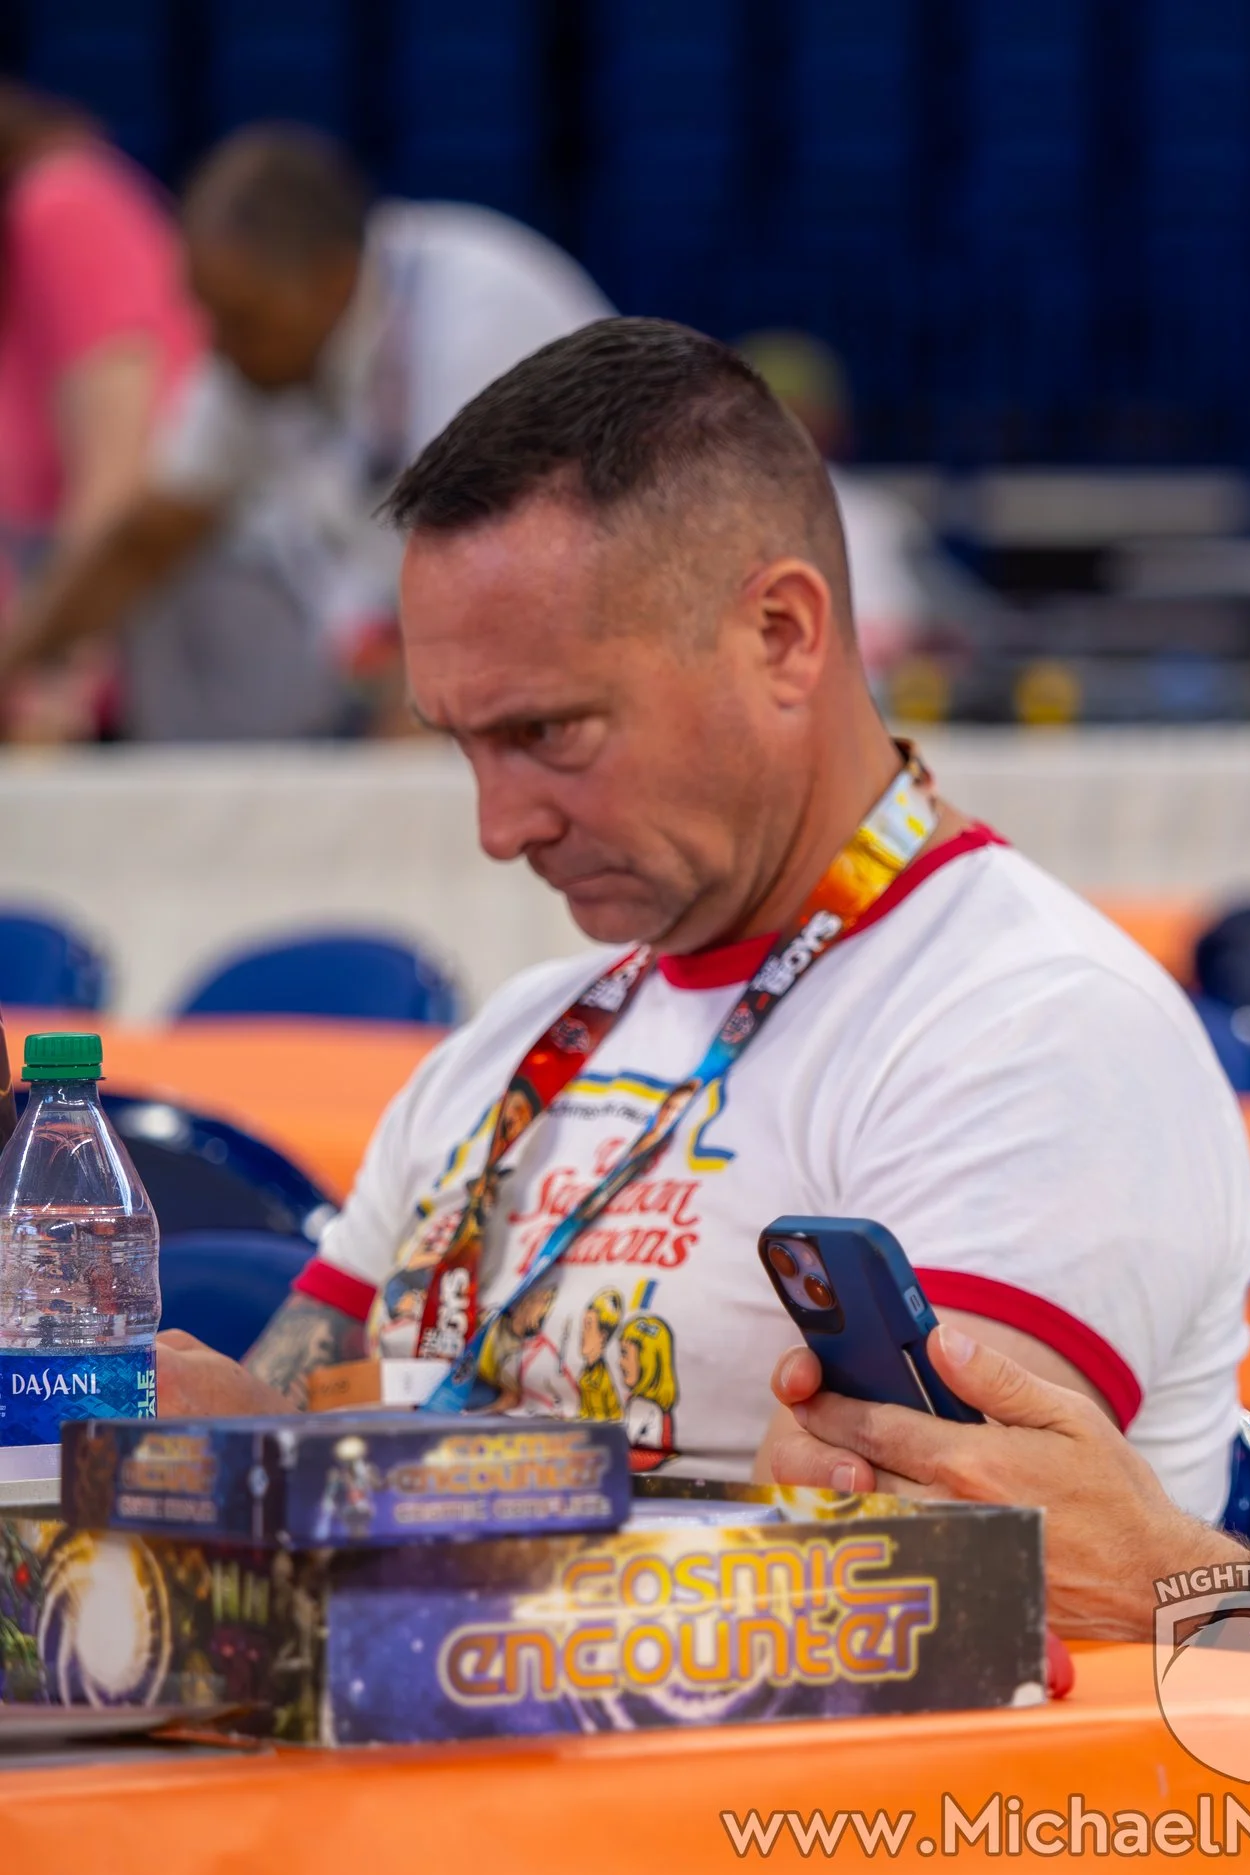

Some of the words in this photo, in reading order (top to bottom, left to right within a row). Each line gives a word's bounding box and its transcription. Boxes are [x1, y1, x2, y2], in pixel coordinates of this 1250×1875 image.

[765, 909, 843, 995] BOYS
[432, 1266, 470, 1358] BOYS
[12, 1368, 98, 1401] DASANI
